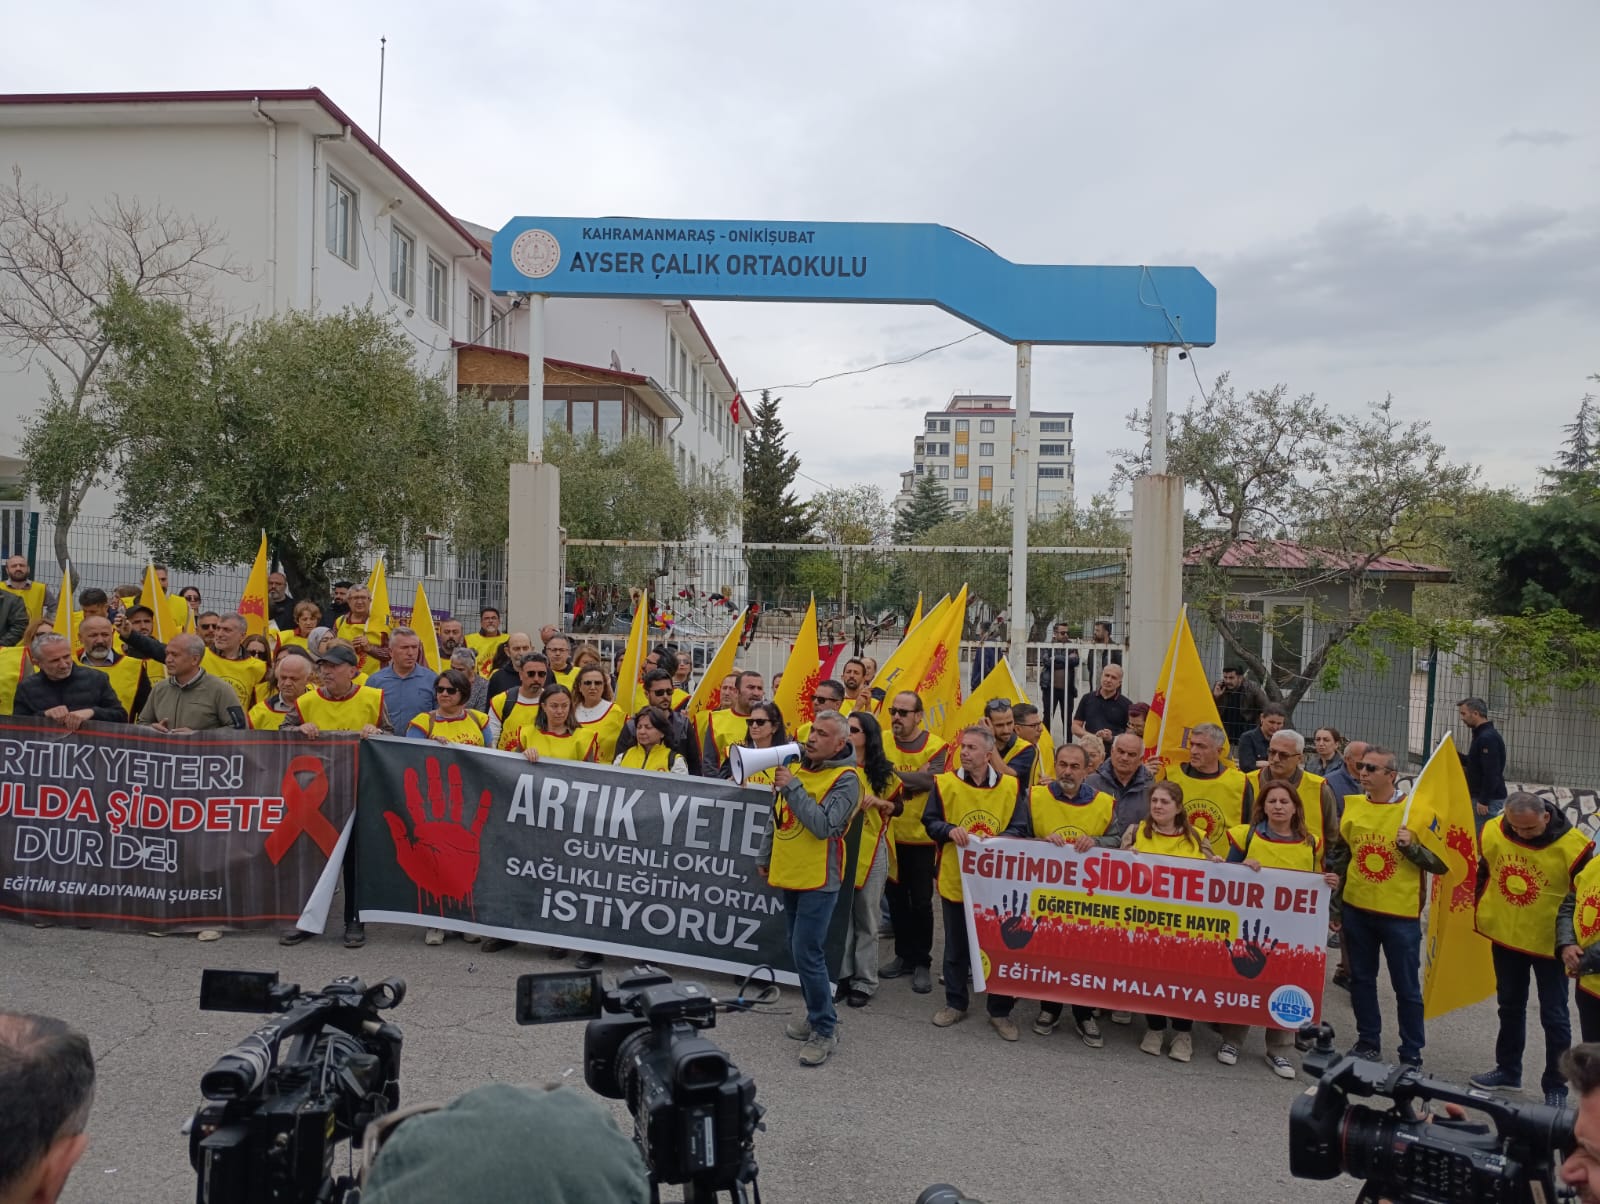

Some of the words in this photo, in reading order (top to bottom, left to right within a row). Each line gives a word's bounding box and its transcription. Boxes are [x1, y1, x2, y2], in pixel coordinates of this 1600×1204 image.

[582, 227, 716, 245] KAHRAMANMARAŞ
[728, 227, 816, 246] ONİKİŞUBAT
[569, 251, 644, 273] AYSER
[651, 252, 721, 280] ÇALIK
[726, 254, 867, 278] ORTAOKULU
[0, 738, 95, 780] RTIK
[99, 746, 244, 790] YETER!
[0, 781, 100, 823] ULDA
[105, 784, 285, 836] ŞİDDETE
[506, 773, 645, 841] ARTIK
[659, 792, 771, 857] YETE
[14, 825, 104, 868] DUR
[110, 834, 178, 873] DE!
[563, 838, 669, 869] GÜVENLİ
[673, 853, 748, 883] OKUL,
[3, 875, 56, 893] EĞİTİM
[59, 880, 87, 896] SEN
[88, 884, 166, 900] ADIYAMAN
[168, 887, 223, 904] ŞUBESİ
[505, 857, 612, 890] SAĞLIKLI
[616, 870, 700, 901] EĞİTİM
[962, 848, 1077, 886] EĞİTİMDE
[1082, 853, 1205, 902] ŞİDDETE
[1208, 879, 1264, 909] DUR
[1274, 886, 1318, 914] DE!
[540, 888, 761, 951] İSTİYORUZ
[1038, 895, 1120, 920] ÖĞRETMENE
[1186, 915, 1231, 934] HAYIR
[998, 963, 1107, 990] EĞİTİM-SEN
[1113, 978, 1207, 1004] MALATYA
[1214, 991, 1261, 1009] ŞUBE
[1271, 1001, 1312, 1018] KESK
